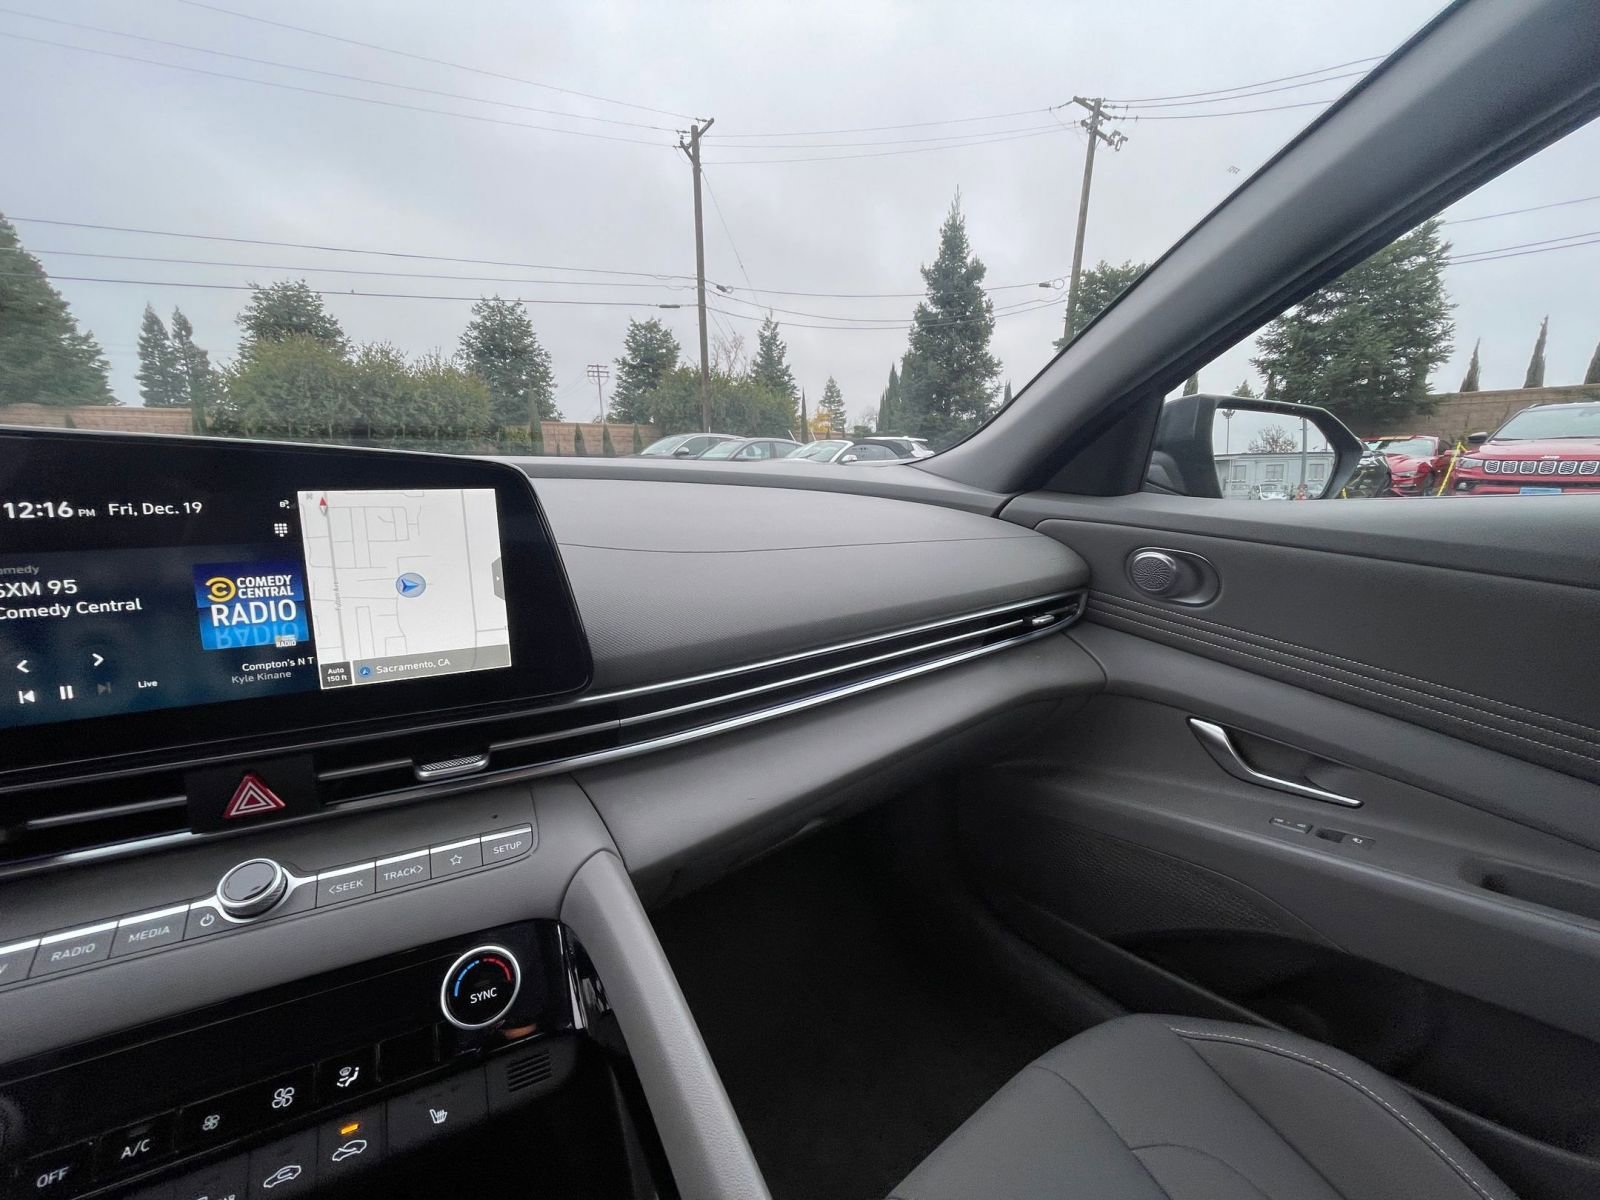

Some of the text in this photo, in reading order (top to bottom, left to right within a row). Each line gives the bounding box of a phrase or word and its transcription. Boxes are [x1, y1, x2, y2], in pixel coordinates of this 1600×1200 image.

[3, 501, 96, 519] 12:16 PM
[108, 501, 202, 516] Fri, Dec. 19
[47, 579, 78, 595] 95
[236, 575, 292, 588] COMEDY
[238, 586, 294, 599] CENTRAL
[76, 598, 143, 614] Central
[211, 599, 297, 627] RADIO
[241, 659, 296, 672] Compton's
[327, 667, 345, 675] Auto
[375, 657, 451, 674] Sacramento, CA
[138, 680, 158, 688] Live
[231, 671, 292, 685] Kyle Kinane
[492, 841, 522, 854] SETUP
[128, 925, 170, 943] MEDIA
[51, 943, 96, 962] RADIO
[469, 987, 497, 1004] SYNC
[120, 1138, 150, 1160] A/C
[36, 1166, 70, 1188] OFF
